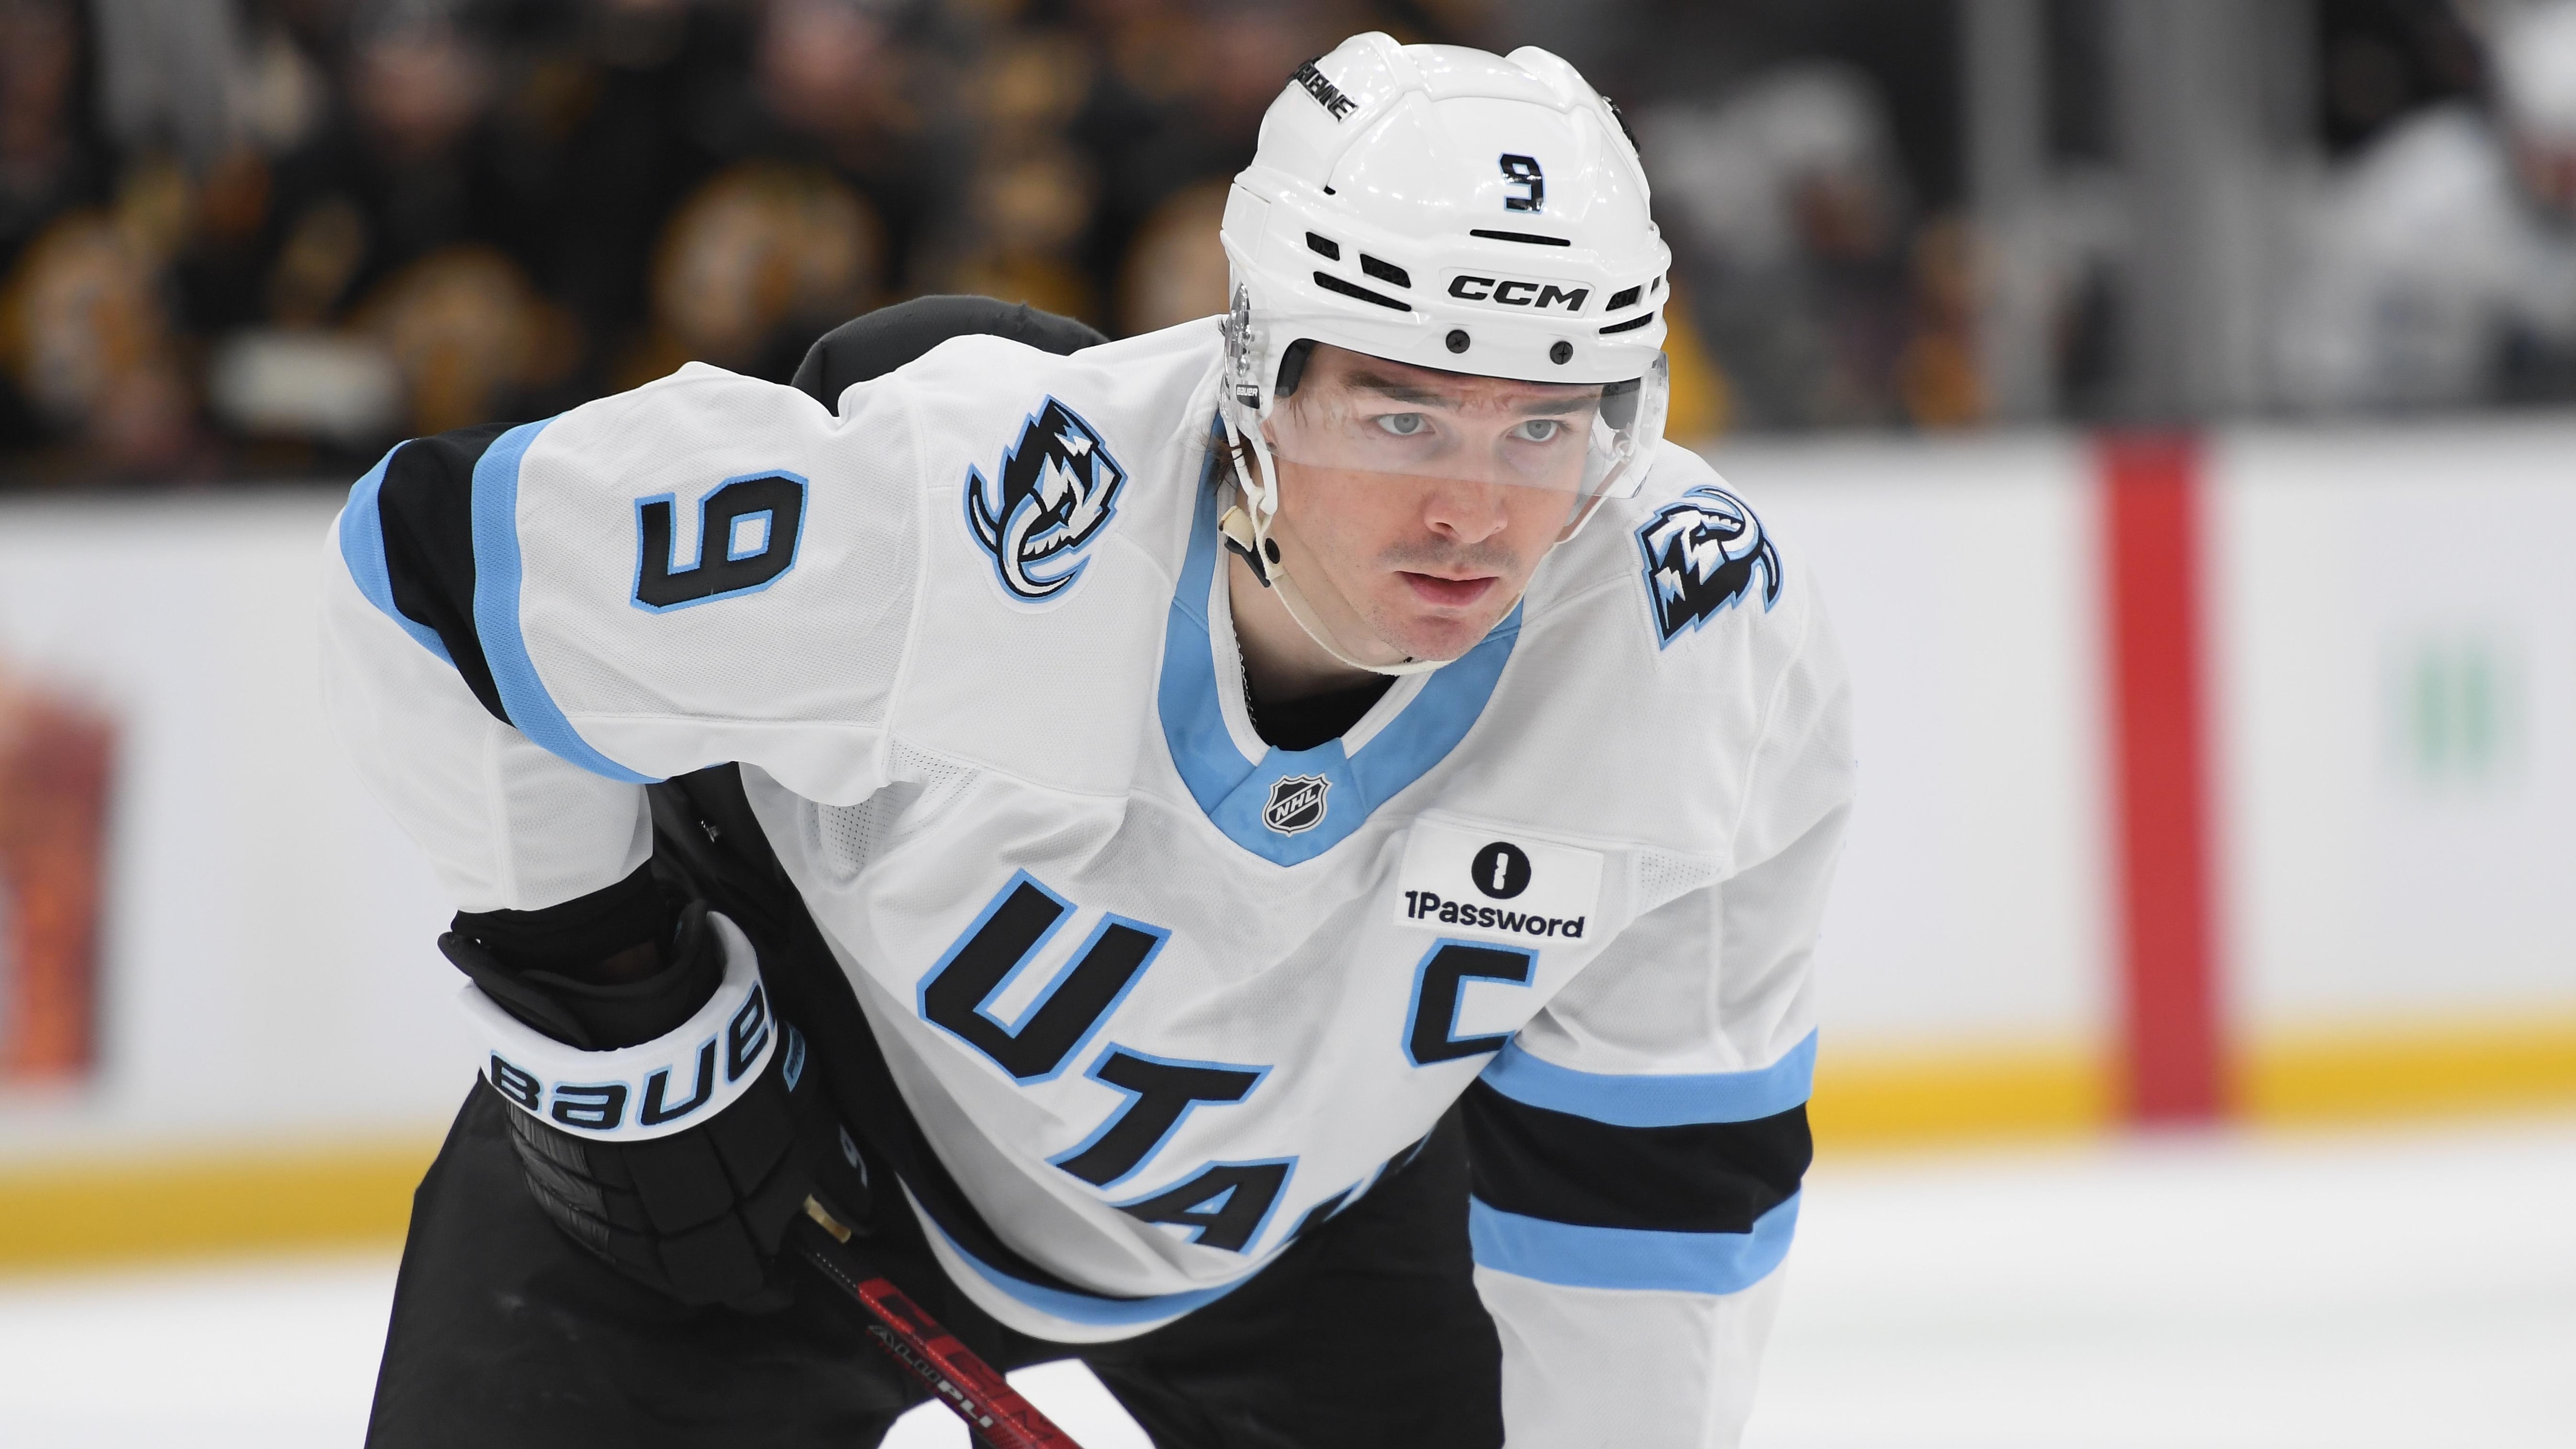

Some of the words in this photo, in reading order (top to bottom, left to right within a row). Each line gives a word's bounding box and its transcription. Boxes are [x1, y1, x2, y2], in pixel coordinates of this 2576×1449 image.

[1498, 152, 1544, 214] 9
[1447, 275, 1590, 312] CCM
[631, 469, 808, 614] 9
[1275, 788, 1317, 822] NHL
[1405, 891, 1585, 939] 1Password
[1401, 937, 1540, 1068] C
